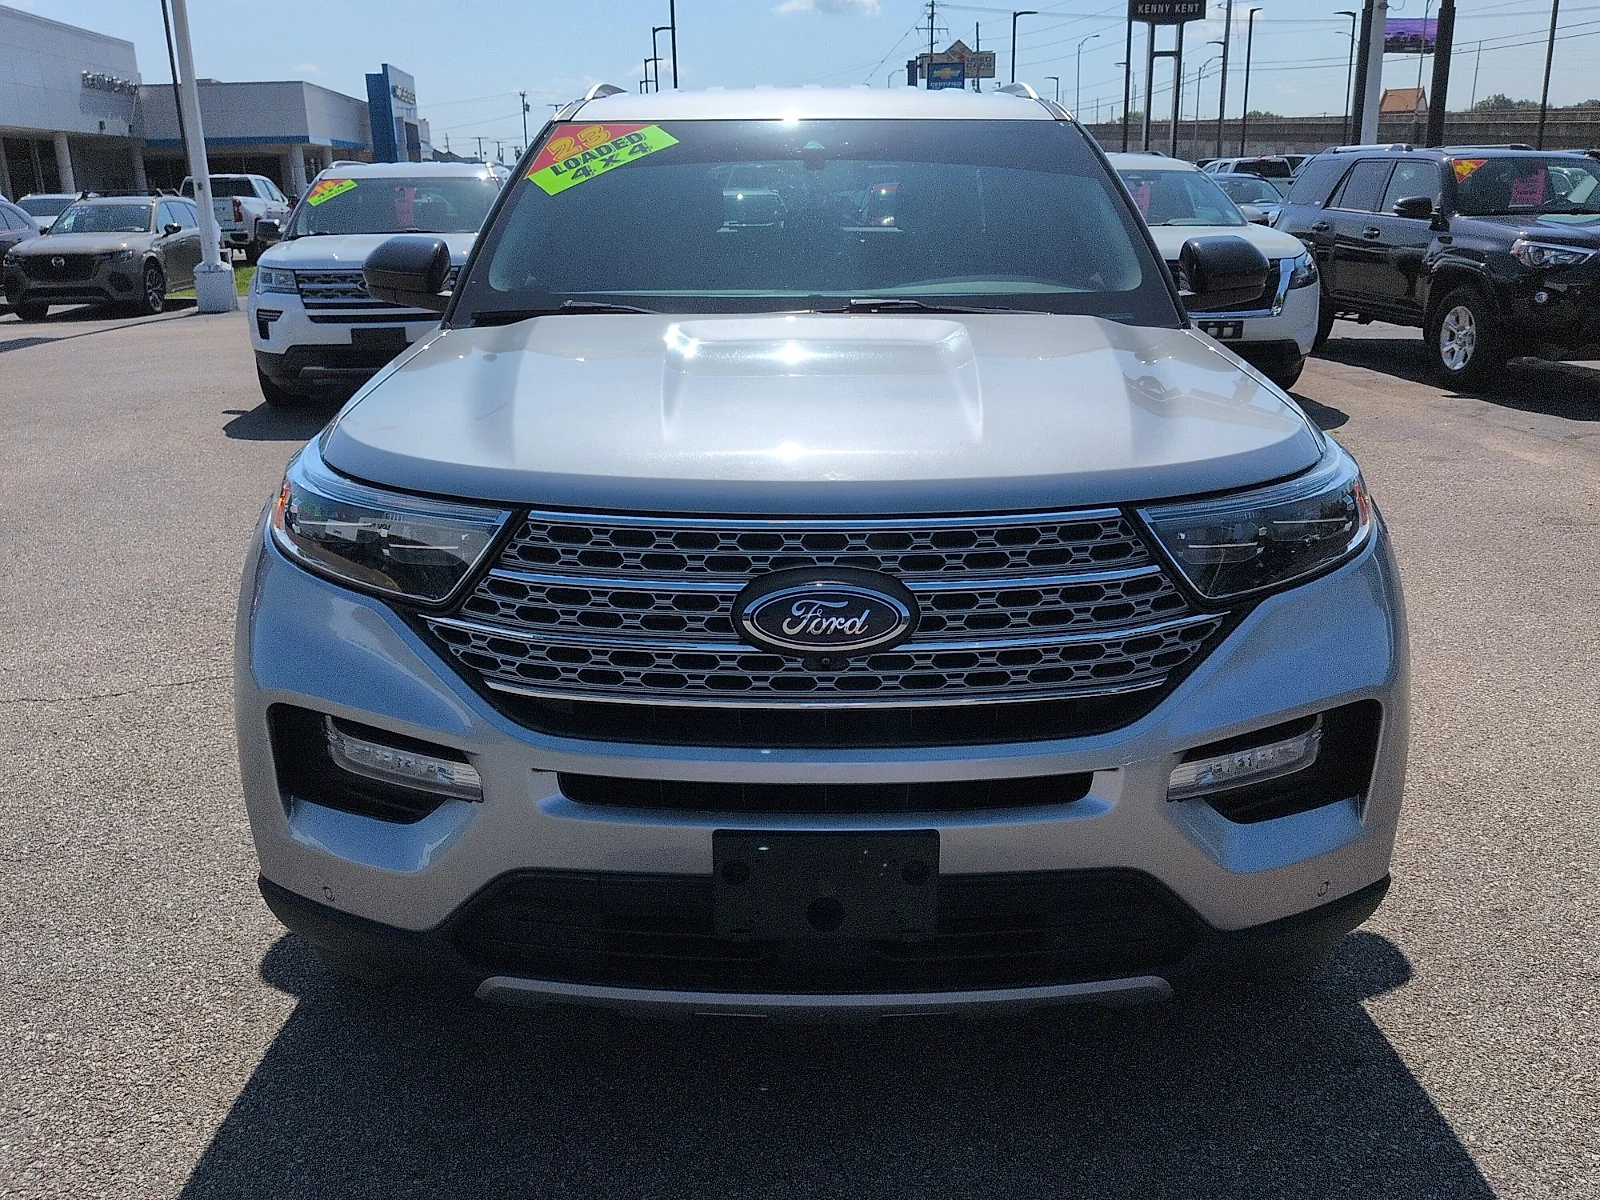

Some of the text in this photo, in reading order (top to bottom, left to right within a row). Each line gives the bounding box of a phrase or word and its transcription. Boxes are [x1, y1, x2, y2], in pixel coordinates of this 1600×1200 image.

[1137, 4, 1200, 13] KENNY KENT
[547, 124, 611, 162] 23
[550, 132, 647, 176] LOADED
[571, 165, 596, 180] 4
[627, 142, 653, 156] 4
[782, 599, 870, 635] Ford
